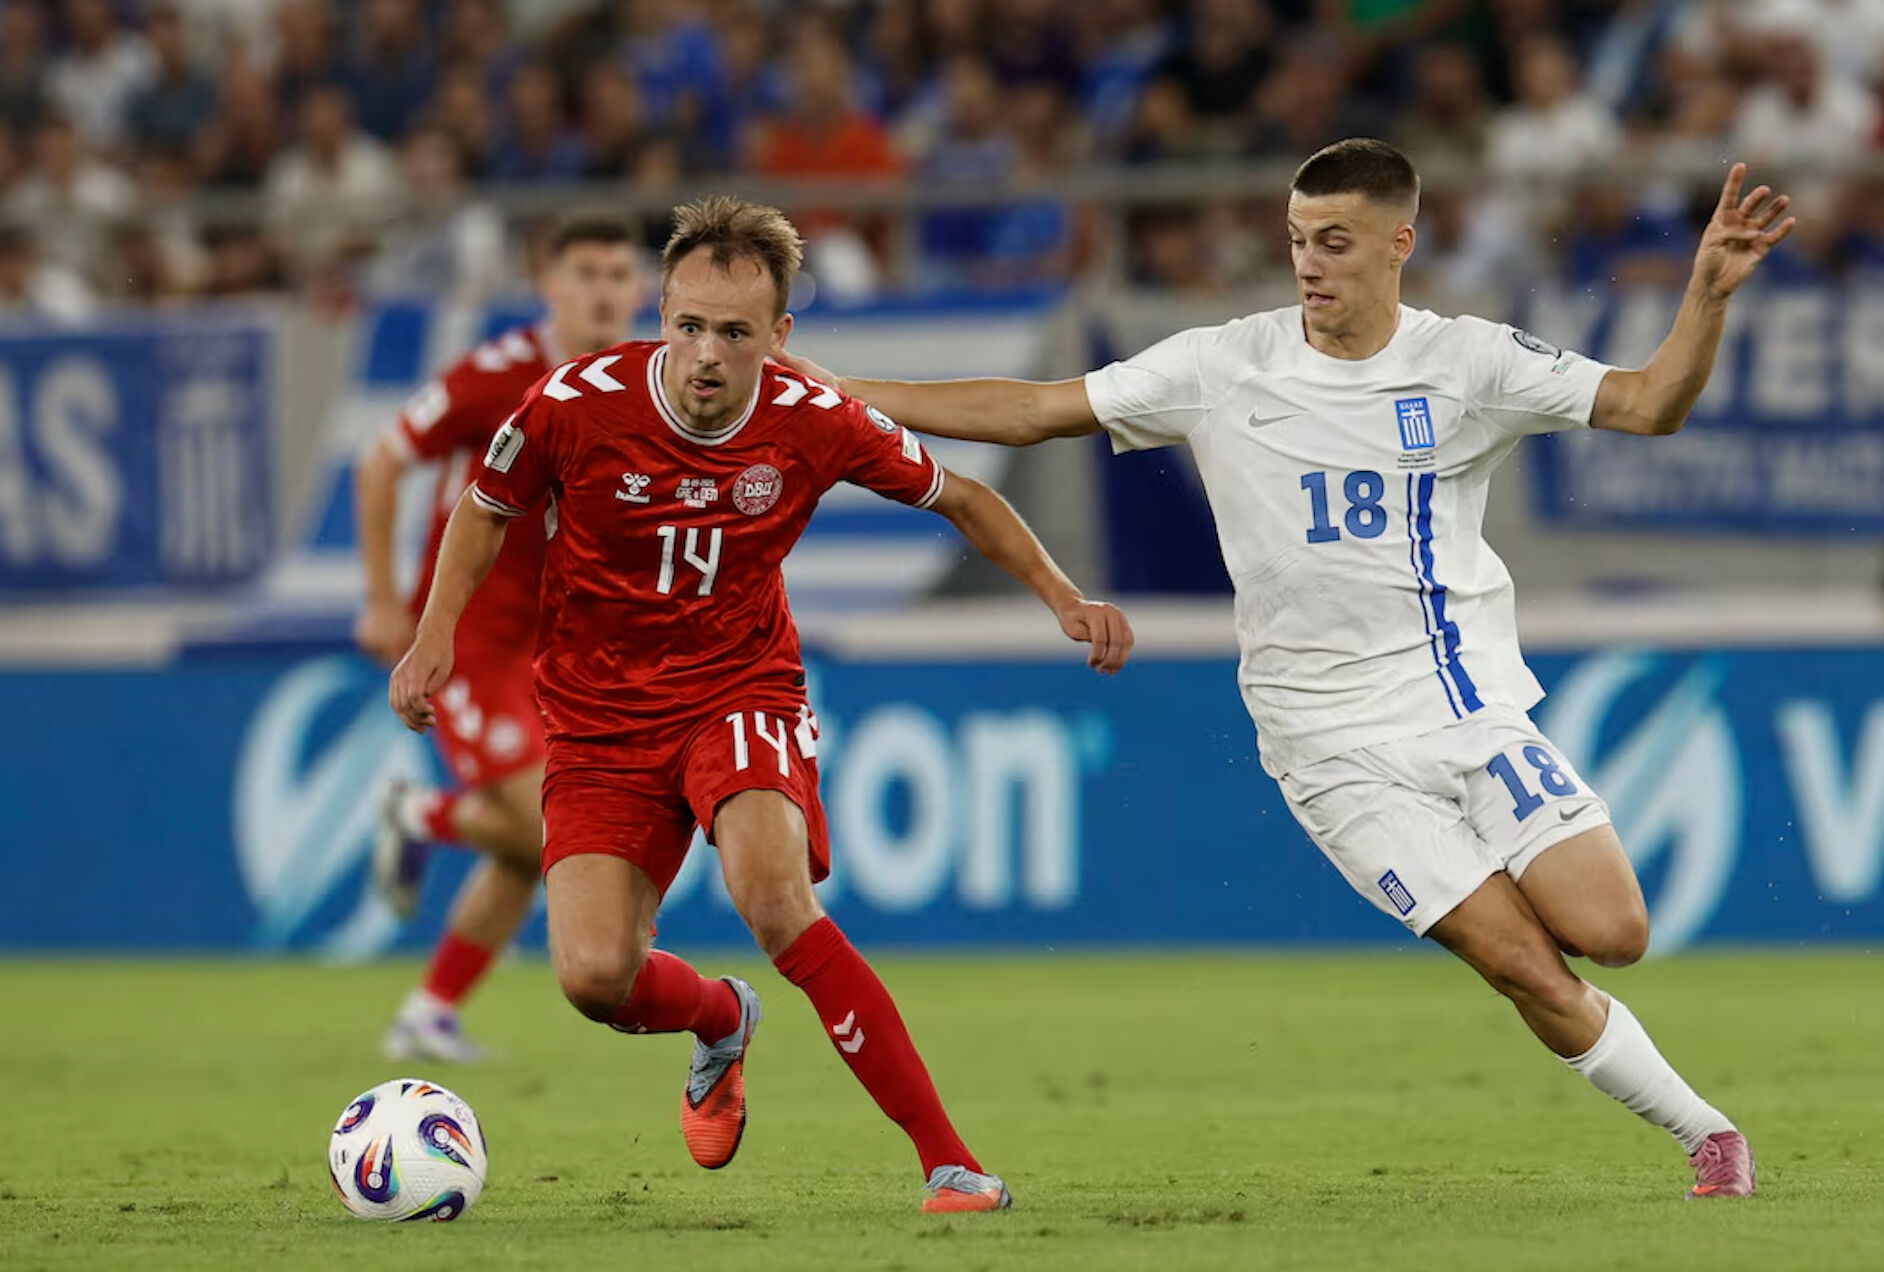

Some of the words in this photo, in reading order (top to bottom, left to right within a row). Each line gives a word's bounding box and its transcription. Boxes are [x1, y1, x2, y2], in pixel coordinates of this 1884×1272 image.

[744, 481, 772, 498] DBU
[1300, 470, 1387, 543] 18
[656, 525, 722, 595] 14
[725, 709, 790, 779] 14
[1486, 745, 1578, 823] 18
